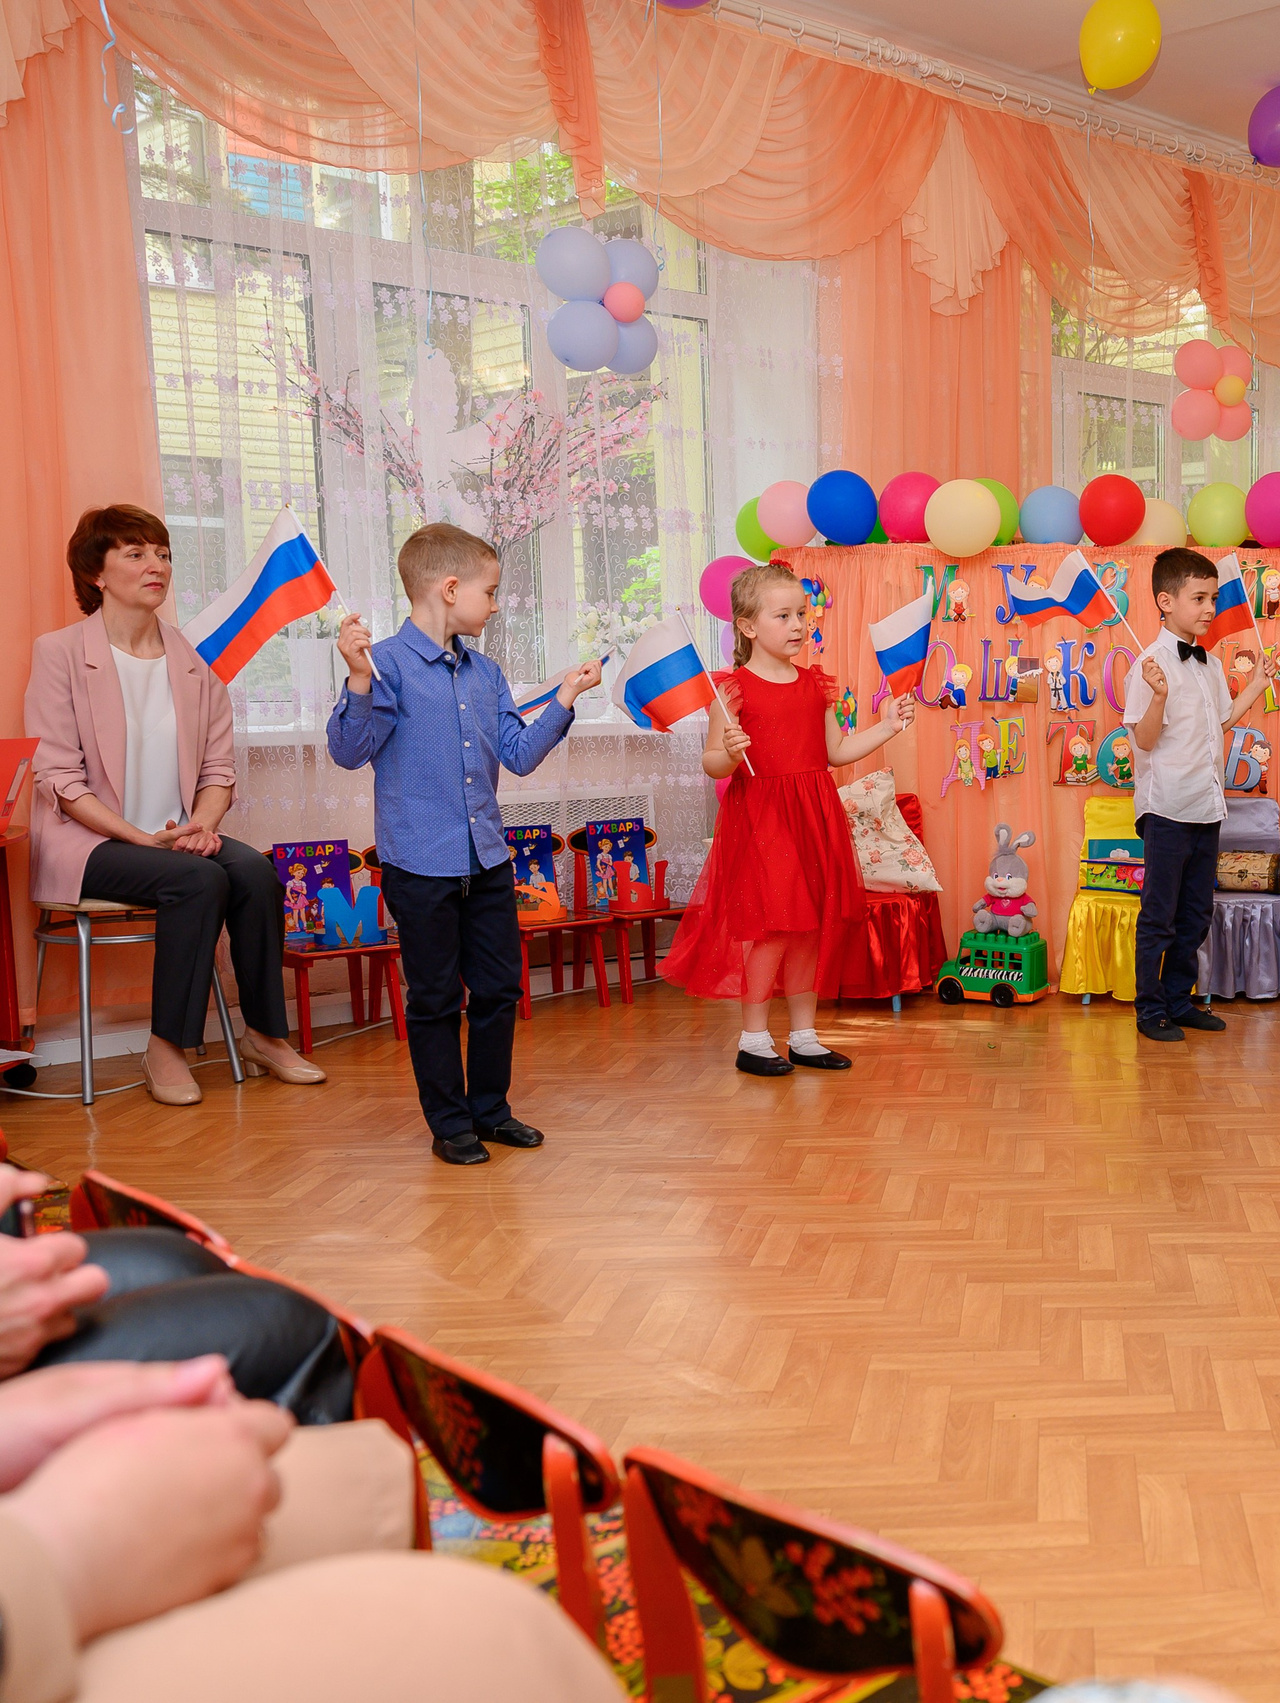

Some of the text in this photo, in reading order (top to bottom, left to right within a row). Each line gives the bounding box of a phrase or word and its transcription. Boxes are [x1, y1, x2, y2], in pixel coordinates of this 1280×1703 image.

[920, 559, 1274, 626] МУЗЙ
[504, 829, 547, 841] КВАРЬ
[588, 822, 641, 836] БУКВАРЬ
[276, 844, 343, 860] БУКВАРЬ
